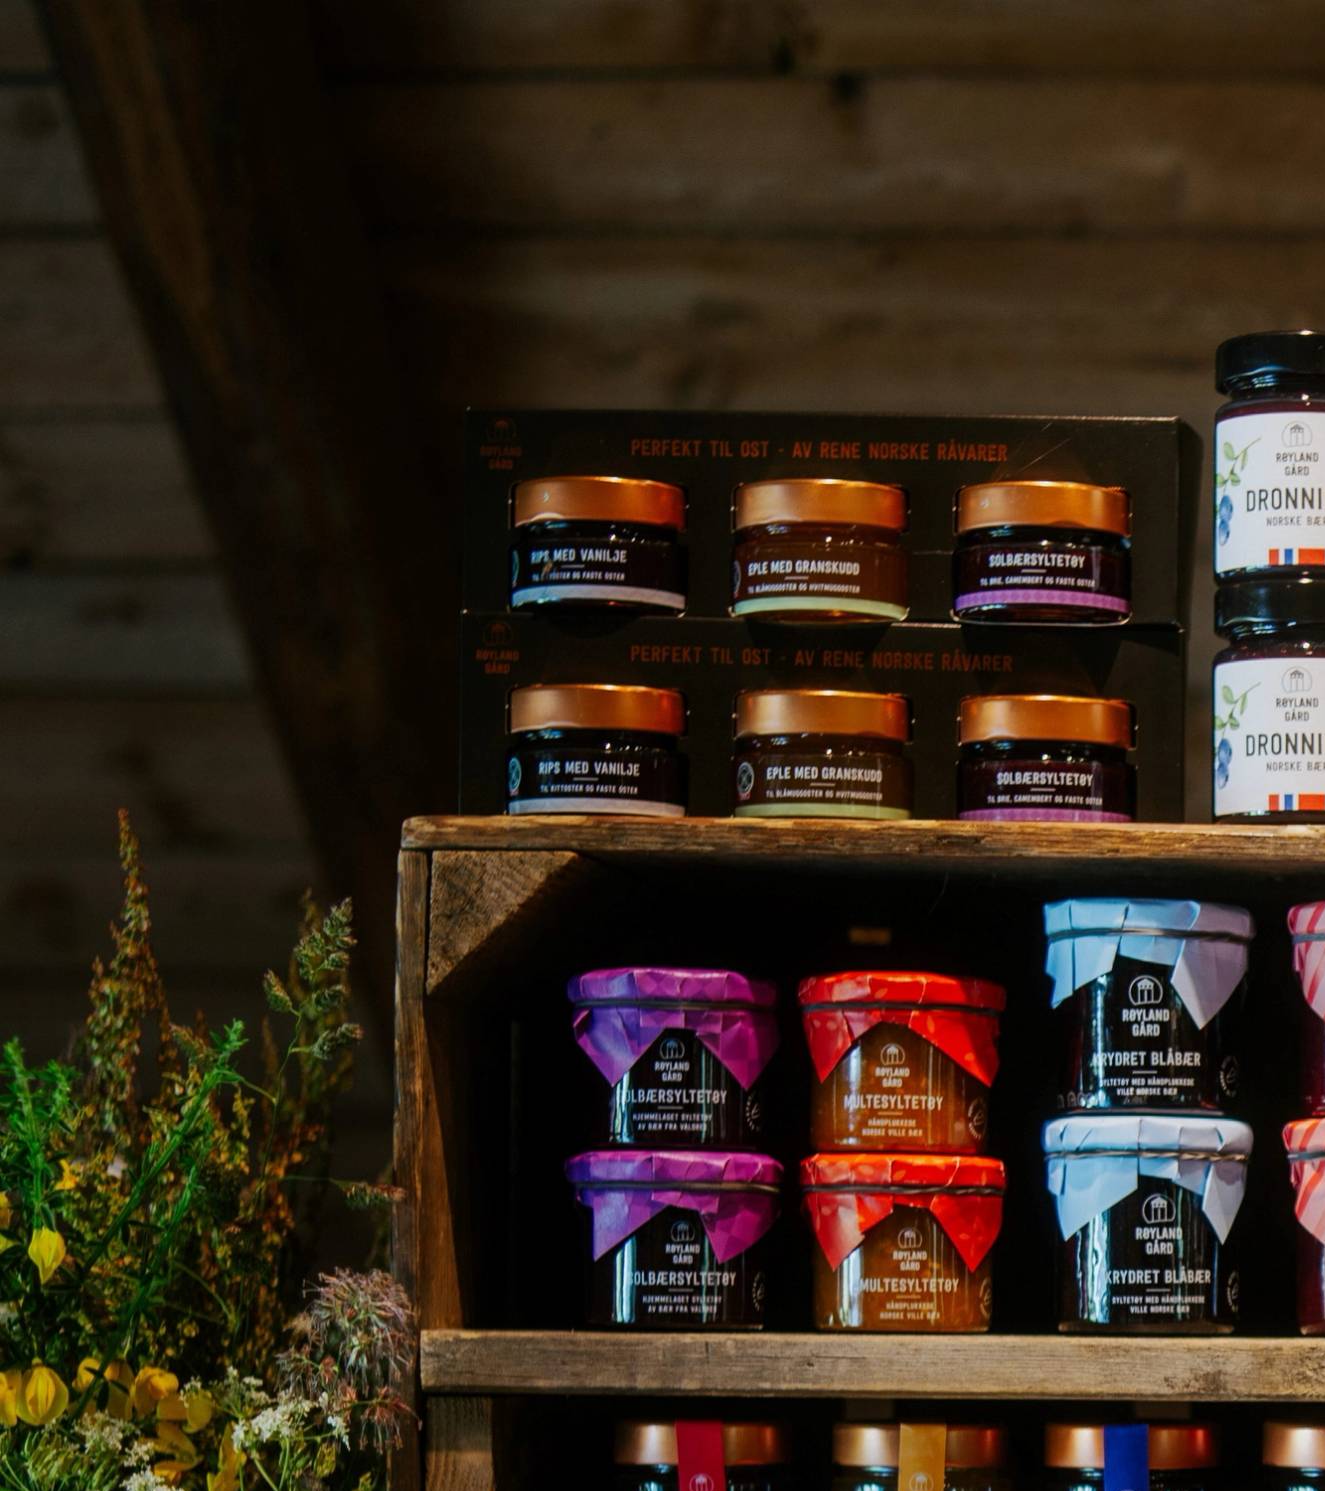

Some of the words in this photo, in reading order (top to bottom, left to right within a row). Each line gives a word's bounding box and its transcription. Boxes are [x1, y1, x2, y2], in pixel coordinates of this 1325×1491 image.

[631, 440, 700, 457] PERFEKT
[711, 440, 732, 457] TIL
[741, 441, 769, 458] OST
[792, 442, 811, 459] AV
[820, 442, 860, 459] RENE
[869, 443, 929, 460] NORSKE
[938, 439, 1008, 462] RÅVARER
[1276, 453, 1319, 463] RØYLAND
[1285, 464, 1310, 476] GÅRD
[1267, 516, 1302, 527] NORSKE
[989, 553, 1085, 568] SOLBÆRSYLTETØY
[748, 562, 769, 576] EPLE
[771, 561, 793, 574] MED
[795, 561, 860, 575] GRANSKUDD
[538, 762, 560, 774] RIPS
[565, 761, 589, 774] MED
[594, 761, 640, 776] VANILJE
[766, 767, 791, 780] EPLE
[794, 766, 819, 779] MED
[822, 767, 883, 783] GRANSKUDD
[996, 772, 1093, 786] SOLBÆRSYLTETØY
[1122, 1009, 1170, 1023] RØYLAND
[1132, 1022, 1160, 1037] GÅRD
[1152, 1048, 1201, 1066] BLÅBÆR
[1106, 1269, 1161, 1284] KRYDRET
[1165, 1267, 1211, 1284] BLÅBÆR
[860, 1278, 959, 1293] MULTESYLTETØY
